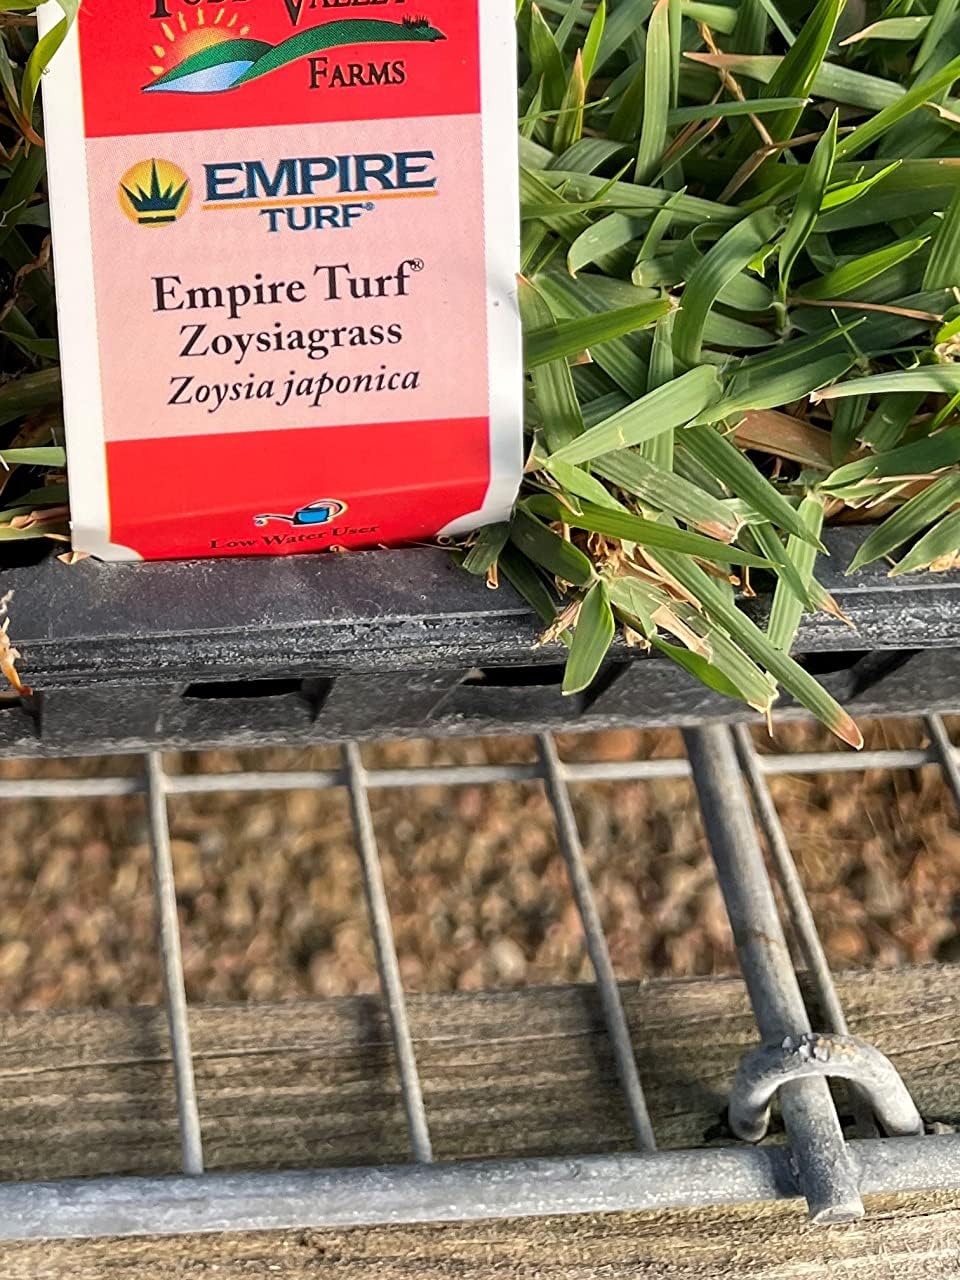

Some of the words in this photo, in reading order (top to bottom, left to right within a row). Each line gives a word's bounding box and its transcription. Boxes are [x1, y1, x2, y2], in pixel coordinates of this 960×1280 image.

[308, 57, 406, 89] FARMS
[202, 150, 437, 202] EMPIRE
[151, 272, 306, 319] Empire
[178, 321, 403, 364] Zoysiagrass
[167, 373, 275, 413] Zoysia
[276, 364, 421, 407] japonica
